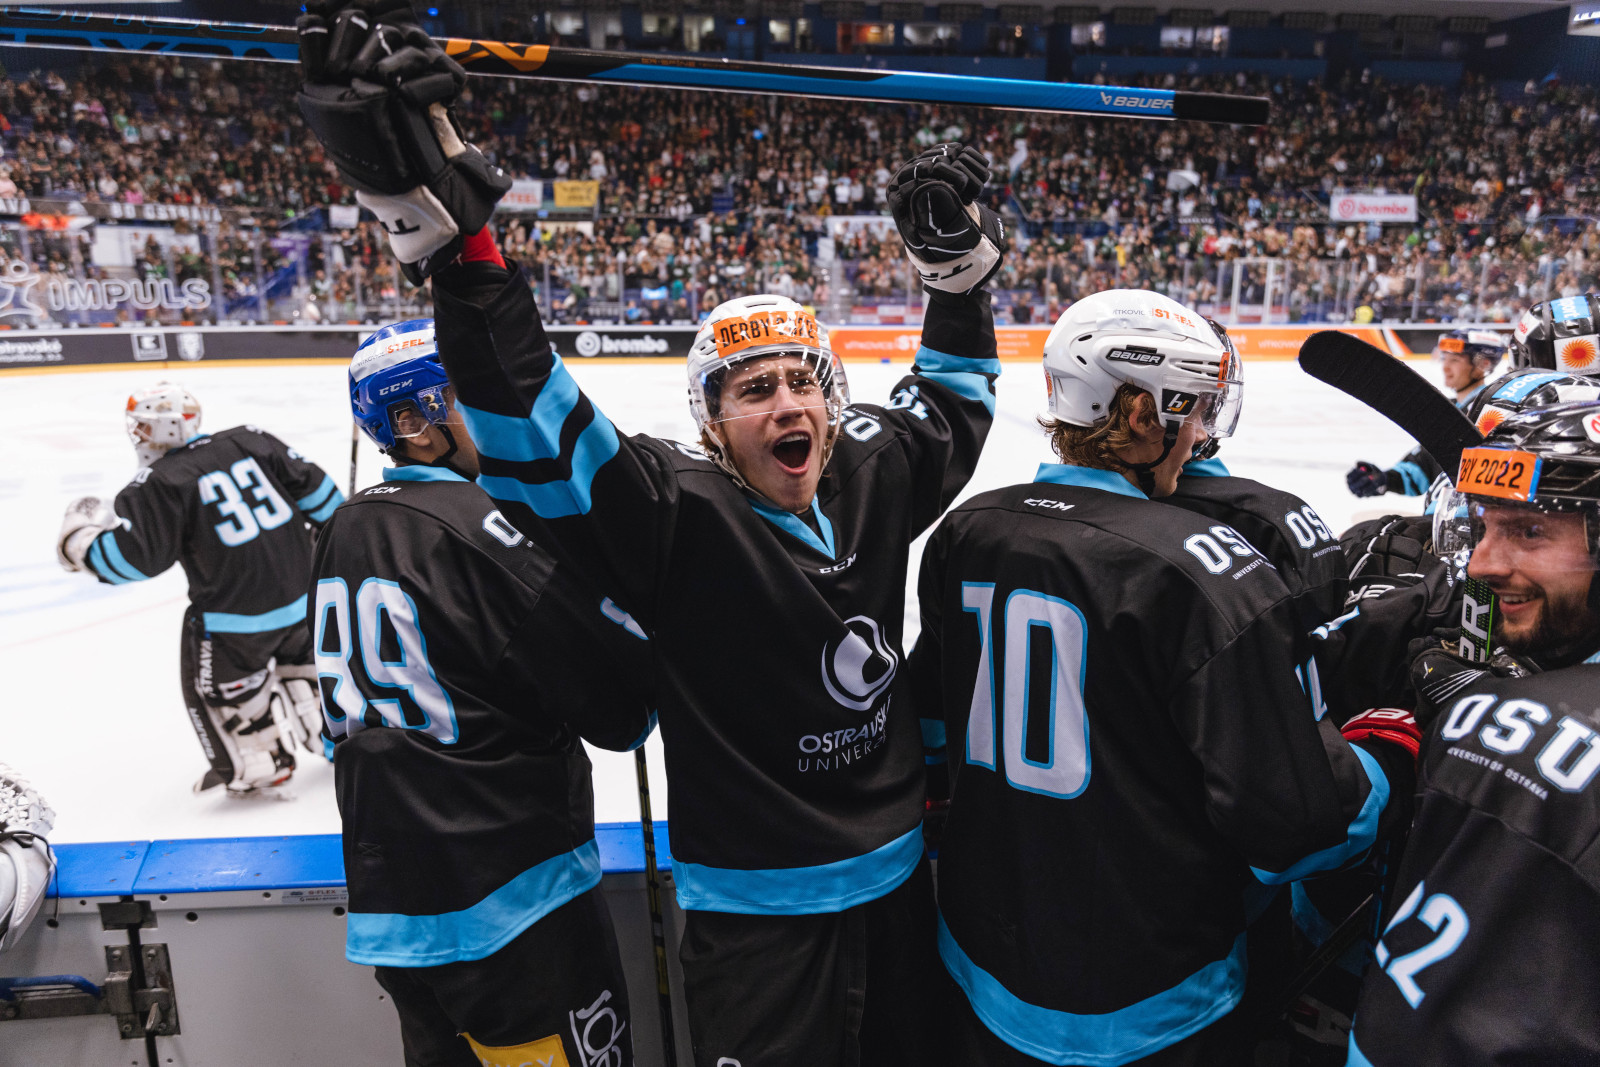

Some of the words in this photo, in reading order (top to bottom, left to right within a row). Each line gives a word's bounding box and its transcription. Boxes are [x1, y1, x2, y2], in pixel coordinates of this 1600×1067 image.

[1113, 96, 1175, 110] BAUER
[49, 277, 212, 311] IMPULS
[387, 338, 425, 354] STEEL
[601, 334, 668, 354] brembo
[720, 318, 770, 348] DERBY
[1109, 350, 1161, 364] BAUER
[379, 379, 413, 396] CCM
[1475, 458, 1524, 489] 2022
[198, 456, 293, 548] 33
[364, 486, 402, 496] CCM
[1023, 497, 1076, 512] CCM
[1285, 504, 1339, 550] OS
[818, 552, 857, 574] CCM
[1183, 525, 1269, 575] OS
[1232, 558, 1264, 581] UNIVERSITY
[314, 576, 460, 745] 89
[961, 580, 1092, 800] 10
[798, 727, 887, 773] UNIVERZ
[1441, 693, 1600, 793] OSU
[1505, 768, 1549, 801] OSTRAVA
